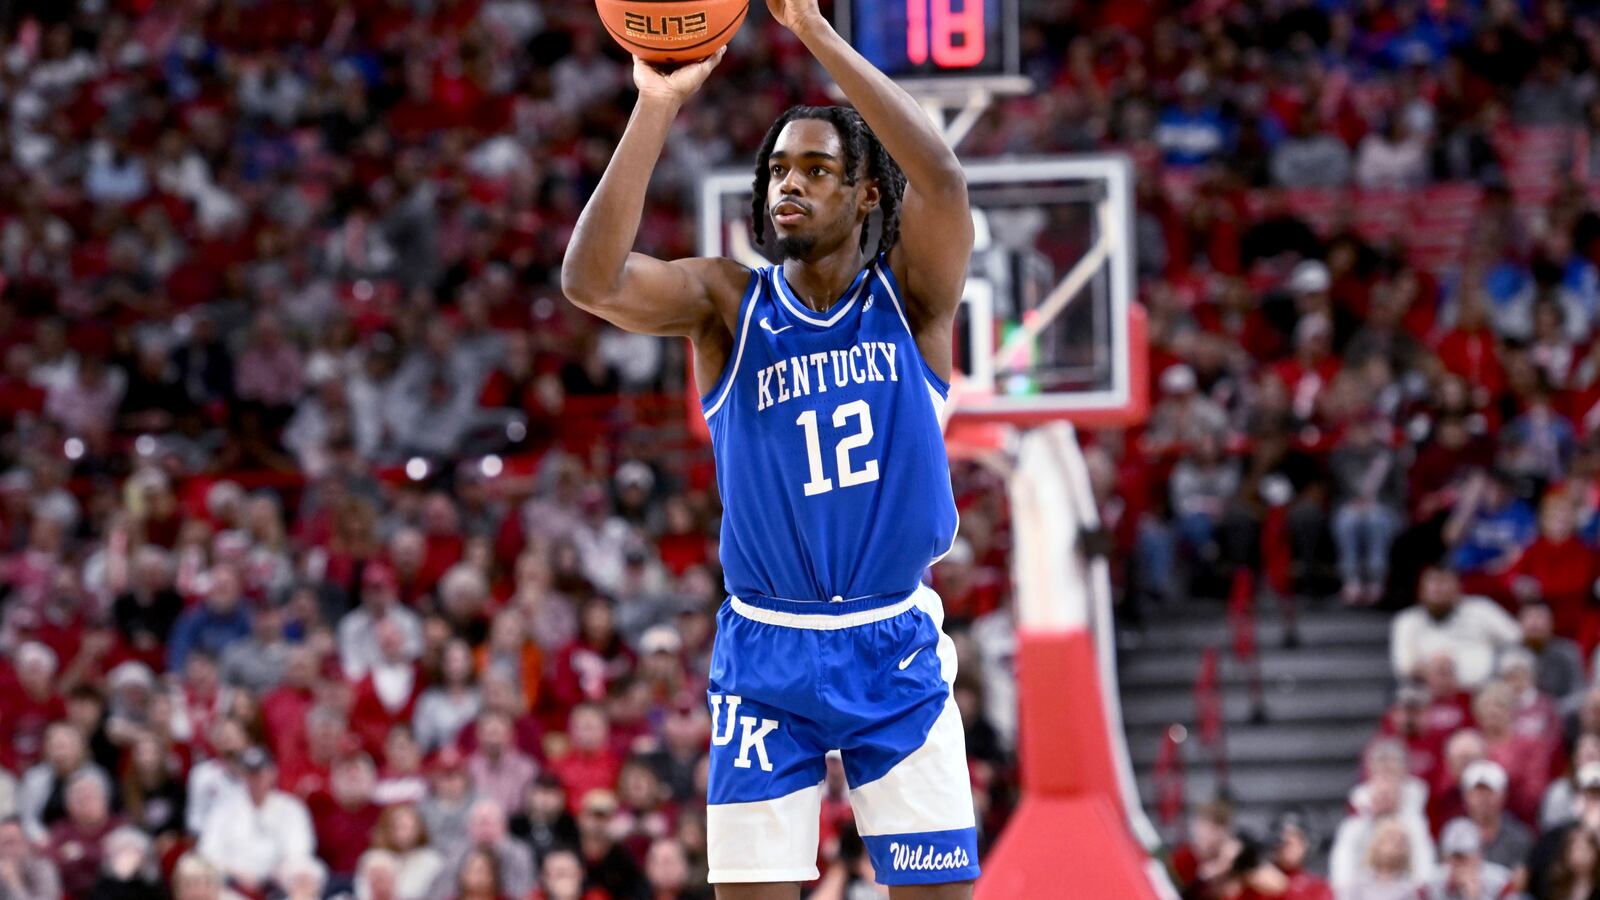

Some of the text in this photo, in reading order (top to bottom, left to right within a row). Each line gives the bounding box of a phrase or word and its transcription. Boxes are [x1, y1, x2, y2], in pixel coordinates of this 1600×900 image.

[624, 11, 707, 35] ELITE
[906, 0, 985, 68] 18
[757, 342, 898, 411] KENTUCKY
[796, 400, 879, 496] 12
[711, 695, 779, 772] UK
[890, 842, 969, 870] Wildcats
